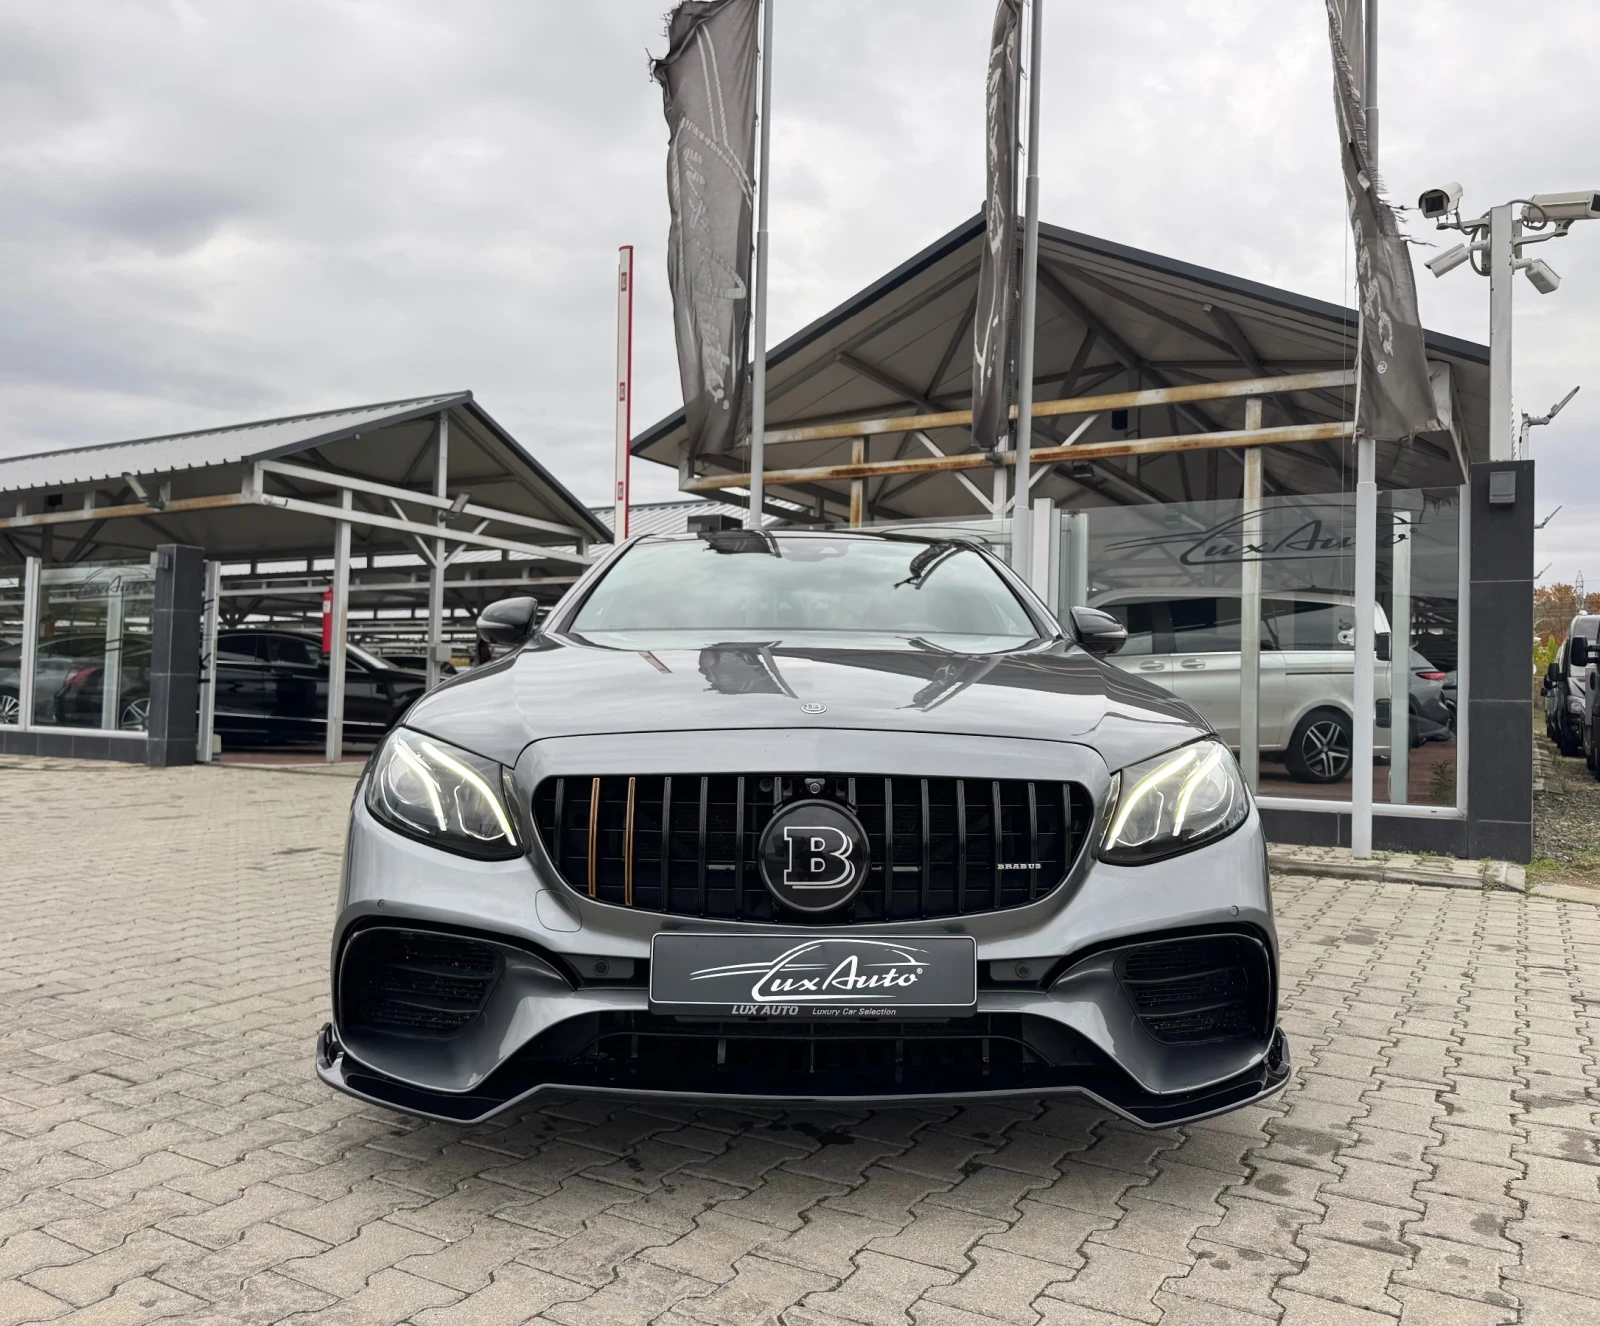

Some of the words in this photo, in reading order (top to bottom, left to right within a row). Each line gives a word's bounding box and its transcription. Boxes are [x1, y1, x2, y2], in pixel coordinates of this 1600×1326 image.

[1273, 519, 1410, 552] Auo
[783, 826, 856, 889] B
[731, 1004, 757, 1015] LUX
[760, 1005, 799, 1015] AUTO
[812, 1007, 841, 1016] Luxury
[842, 1007, 857, 1015] Car
[858, 1008, 897, 1016] Selection
